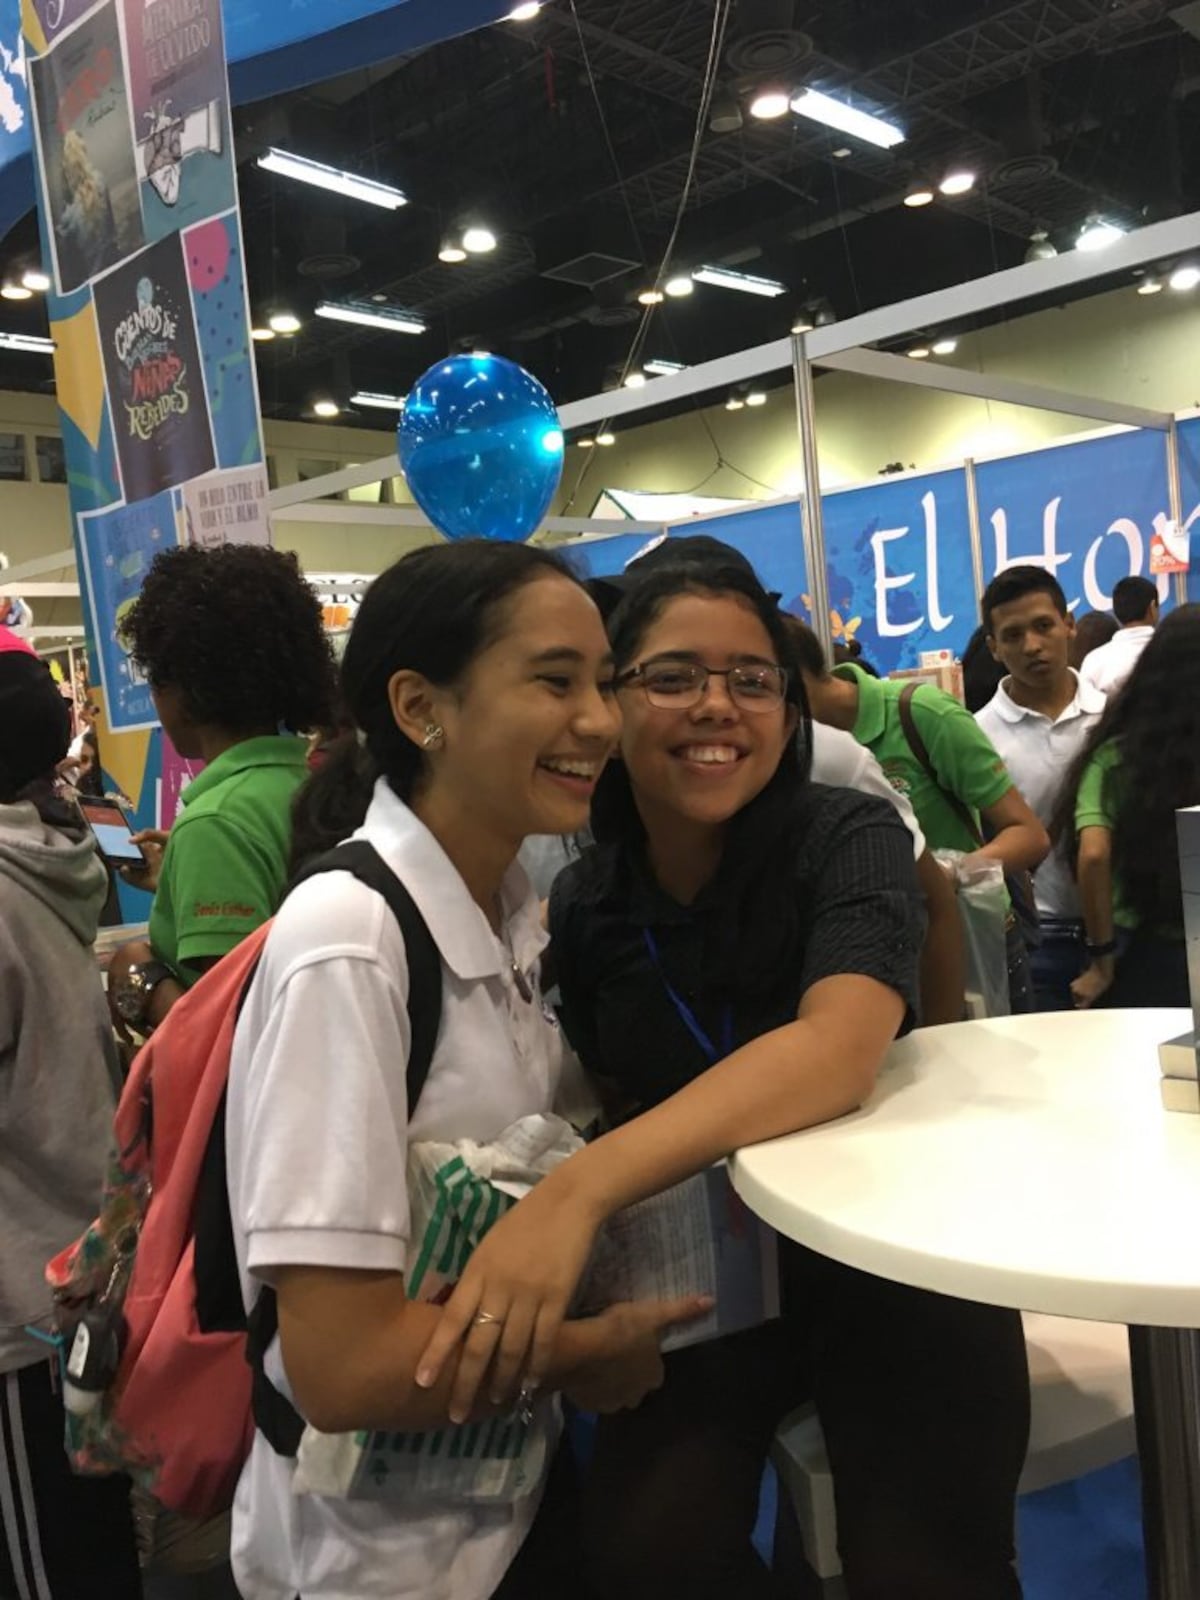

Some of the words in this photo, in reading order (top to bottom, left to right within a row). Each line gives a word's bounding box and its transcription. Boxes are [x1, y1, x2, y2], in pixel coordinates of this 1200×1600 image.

[164, 311, 178, 340] DE
[124, 364, 189, 440] REBELDES
[226, 482, 254, 504] ENTRE
[871, 491, 954, 637] El
